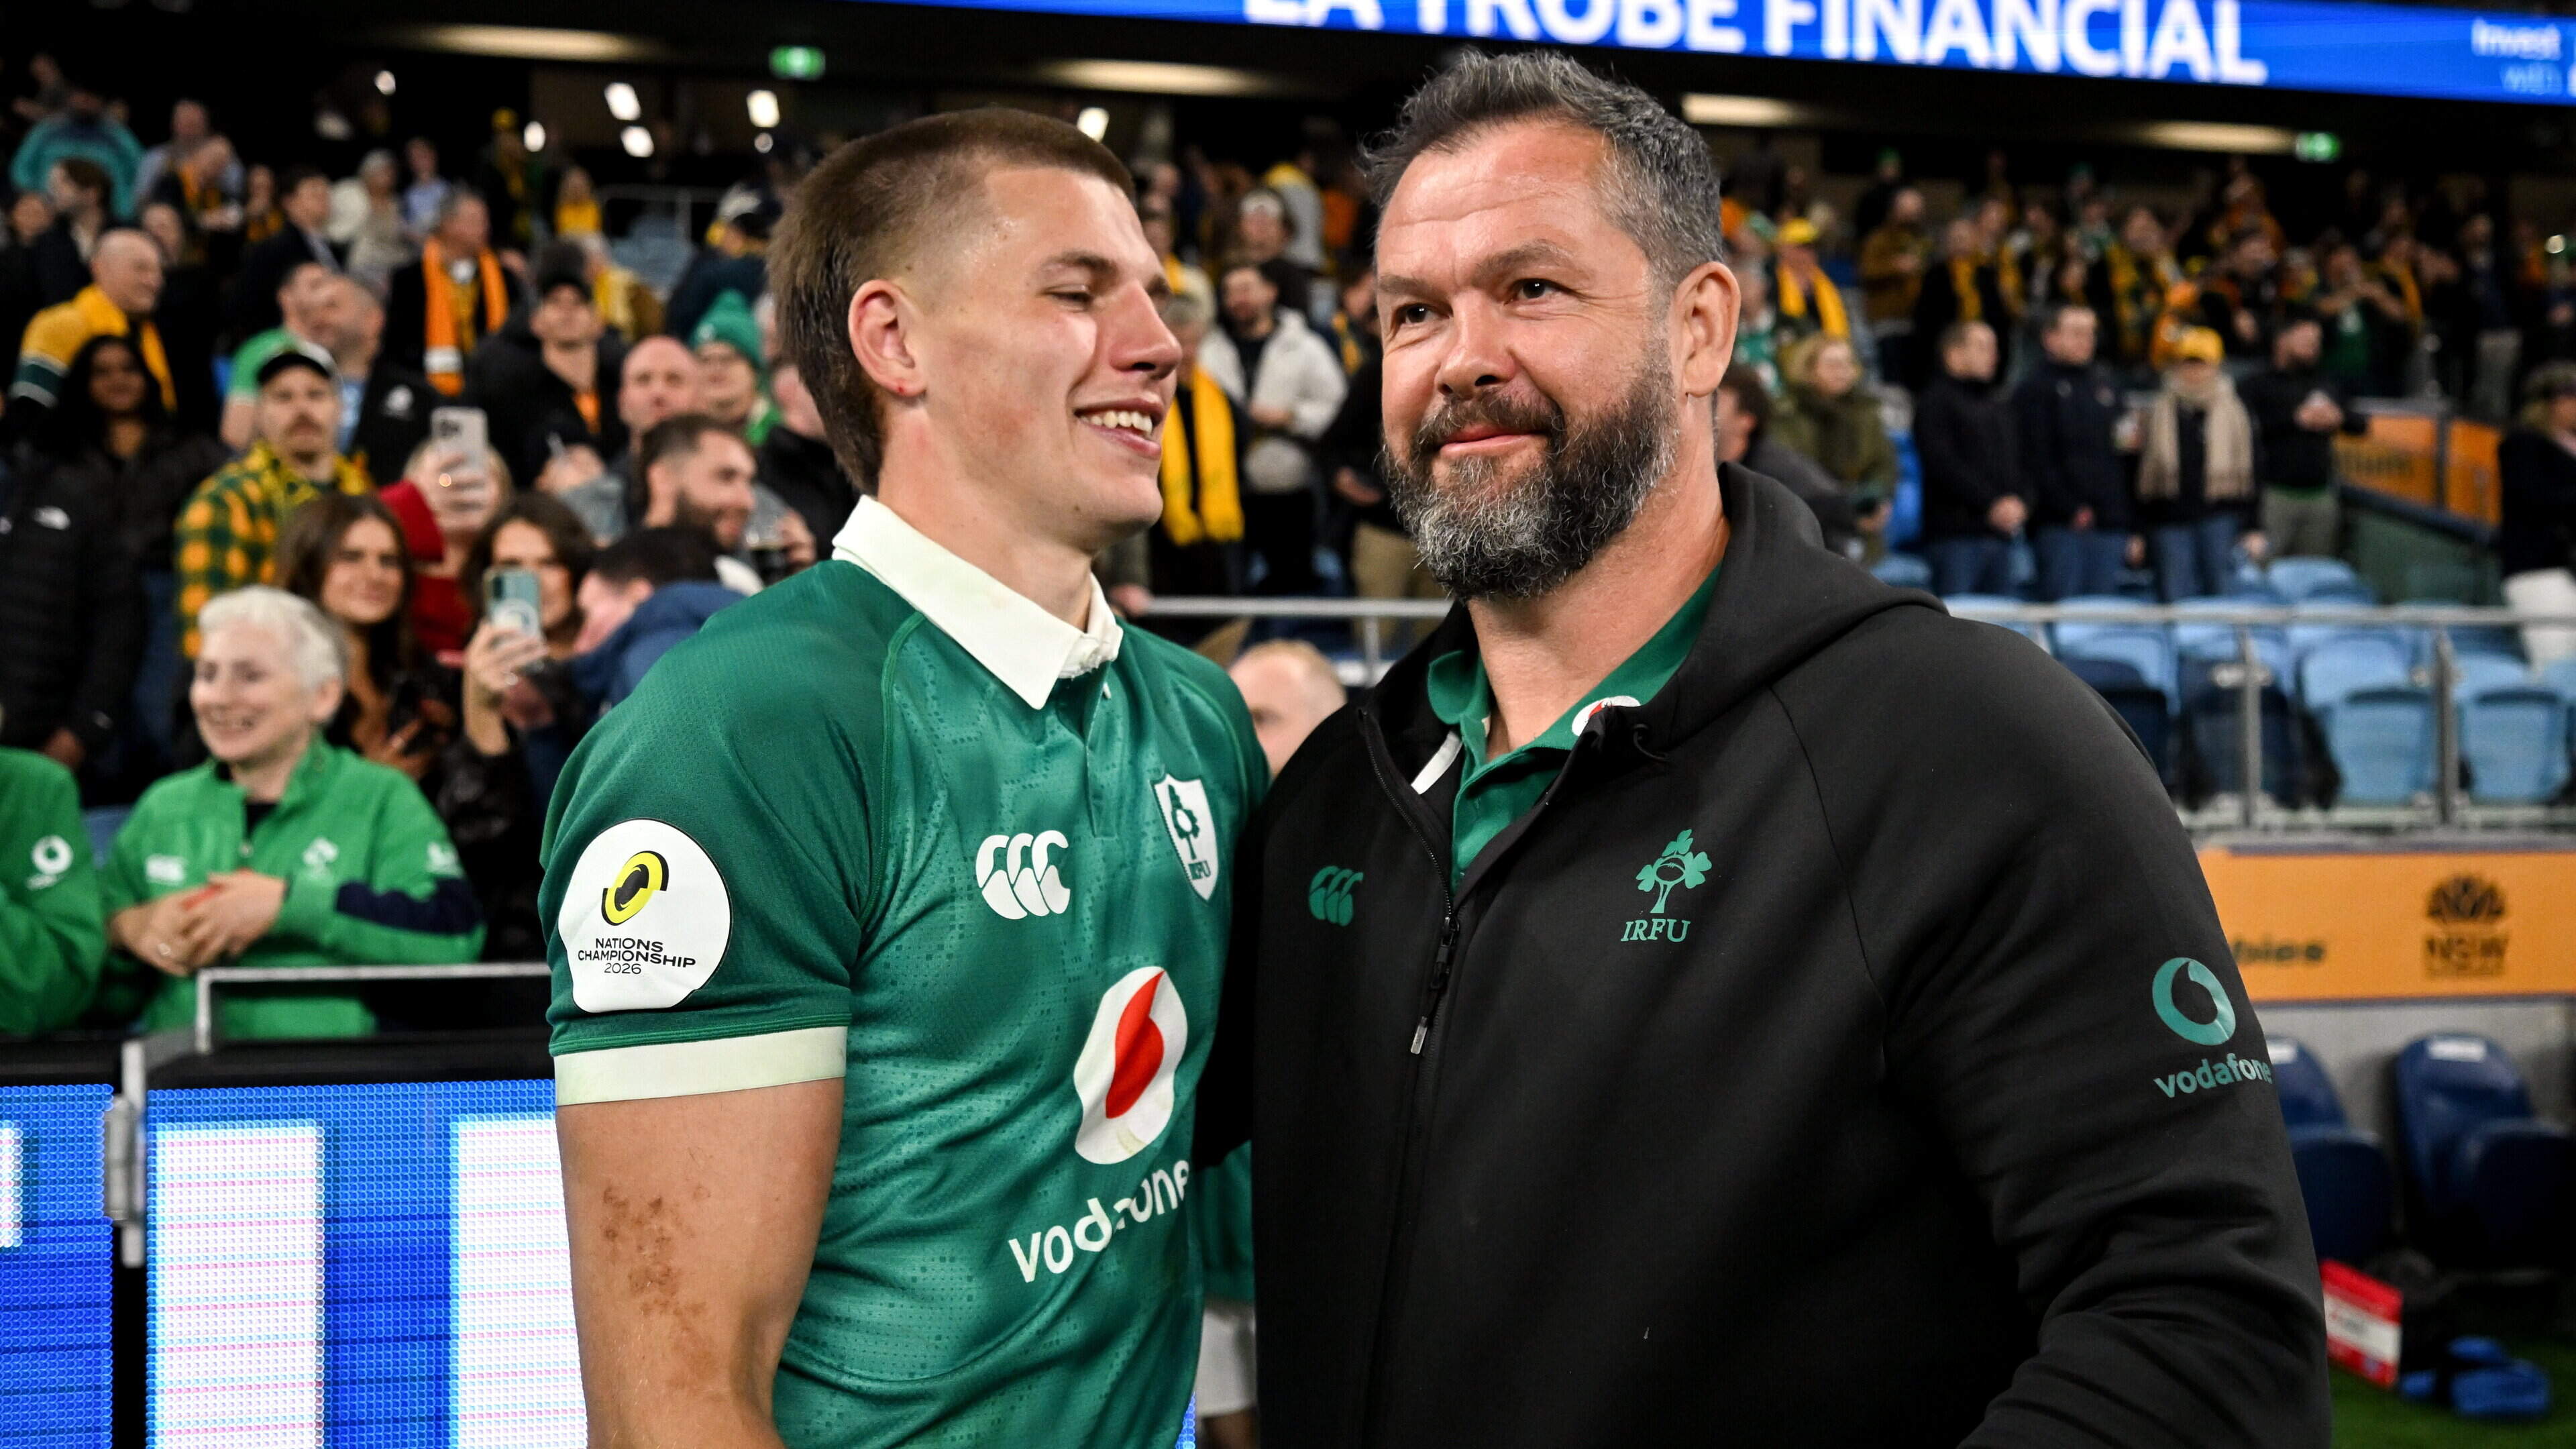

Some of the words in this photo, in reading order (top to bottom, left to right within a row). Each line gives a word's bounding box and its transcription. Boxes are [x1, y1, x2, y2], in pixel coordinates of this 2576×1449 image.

[1763, 0, 2269, 86] FINANCIAL
[1620, 918, 1691, 943] IRFU
[595, 937, 663, 953] NATIONS
[578, 949, 696, 968] CHAMPIONSHIP
[604, 962, 642, 975] 2026
[2153, 1052, 2273, 1099] vodafone
[1008, 1159, 1190, 1283] vodone
